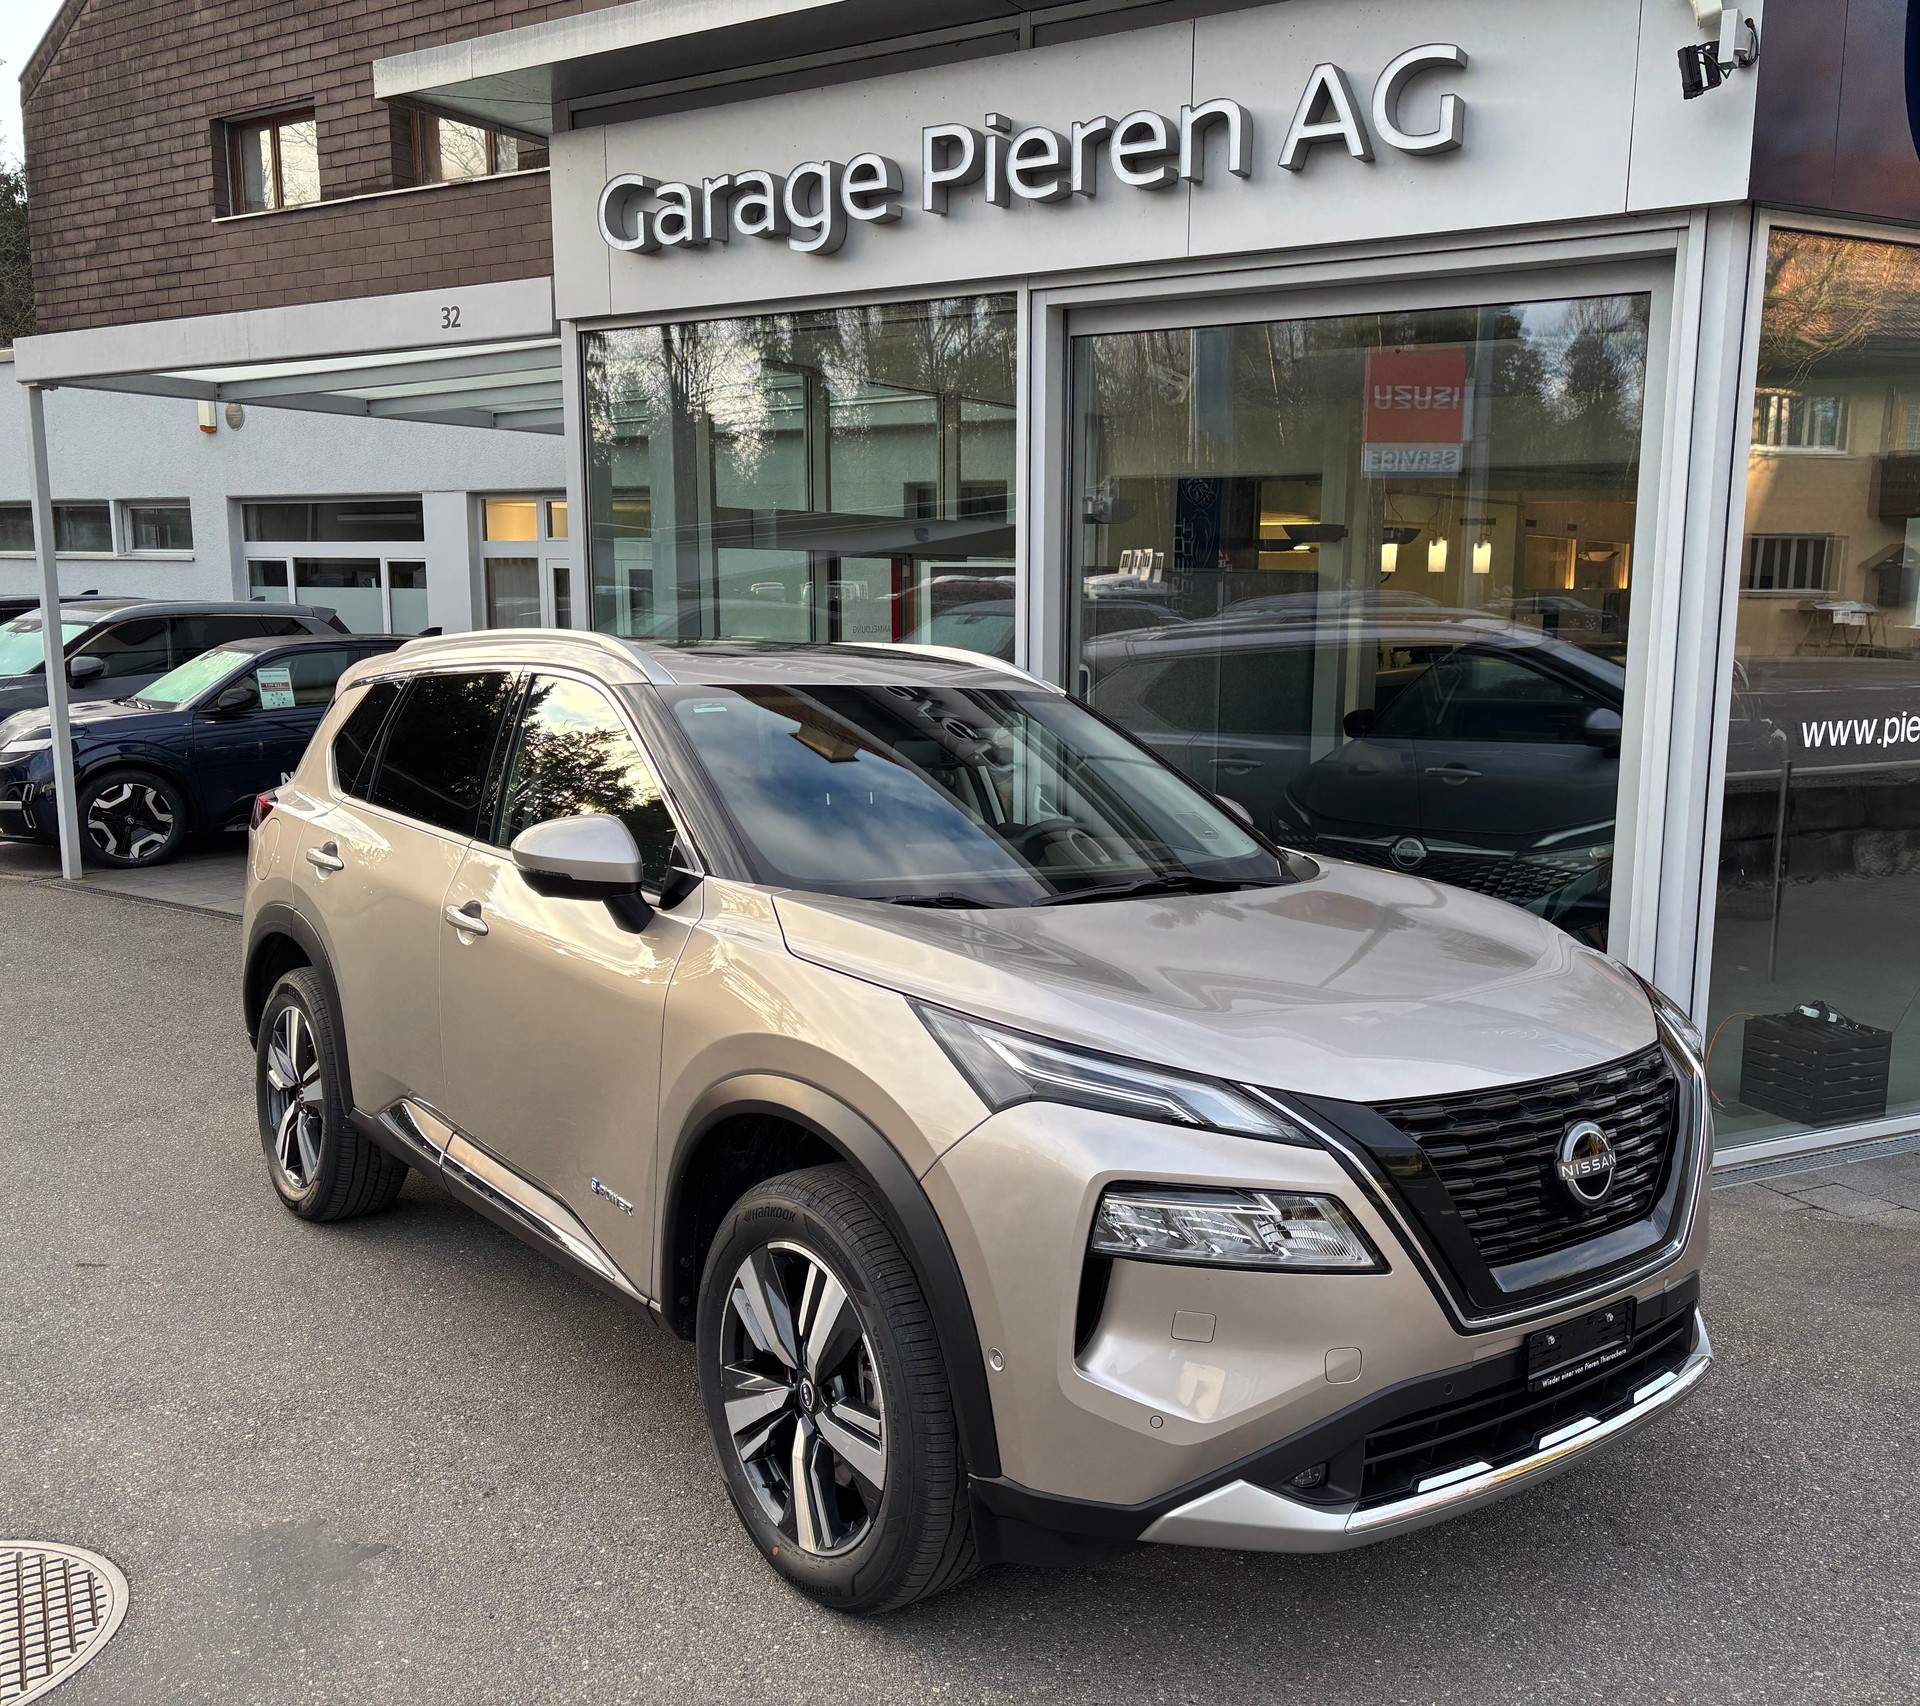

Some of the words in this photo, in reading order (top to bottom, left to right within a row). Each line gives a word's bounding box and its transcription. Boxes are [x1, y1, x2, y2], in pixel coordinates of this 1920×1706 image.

[597, 152, 904, 256] Garage
[922, 97, 1253, 215] Pieren
[1278, 42, 1468, 172] AG
[441, 305, 461, 329] 32
[1561, 1151, 1616, 1177] NISSAN
[1542, 1375, 1561, 1388] Wieder
[1561, 1369, 1575, 1380] einer
[1575, 1366, 1584, 1374] von
[1584, 1360, 1600, 1371] Pieren
